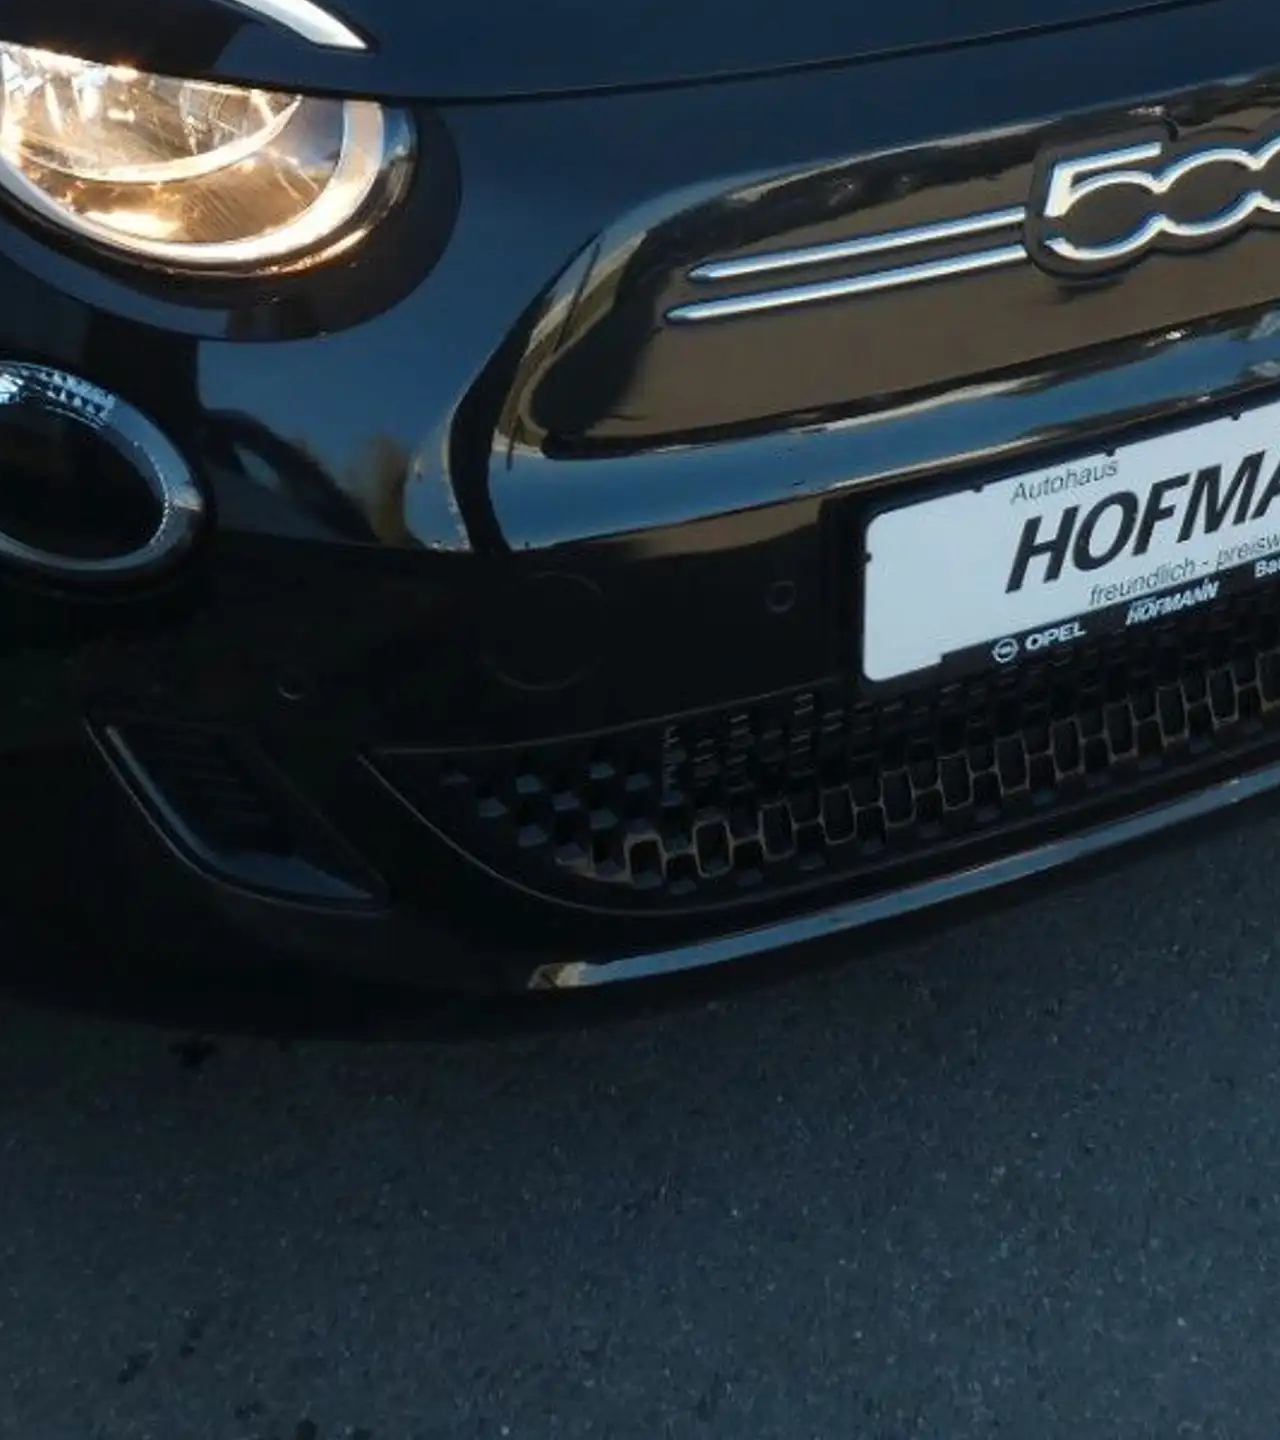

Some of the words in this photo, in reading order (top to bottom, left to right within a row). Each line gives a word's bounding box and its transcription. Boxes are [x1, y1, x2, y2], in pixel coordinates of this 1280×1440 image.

[1010, 460, 1119, 504] Autohaus
[1088, 557, 1196, 606] freundlich
[1024, 620, 1088, 651] OPEL
